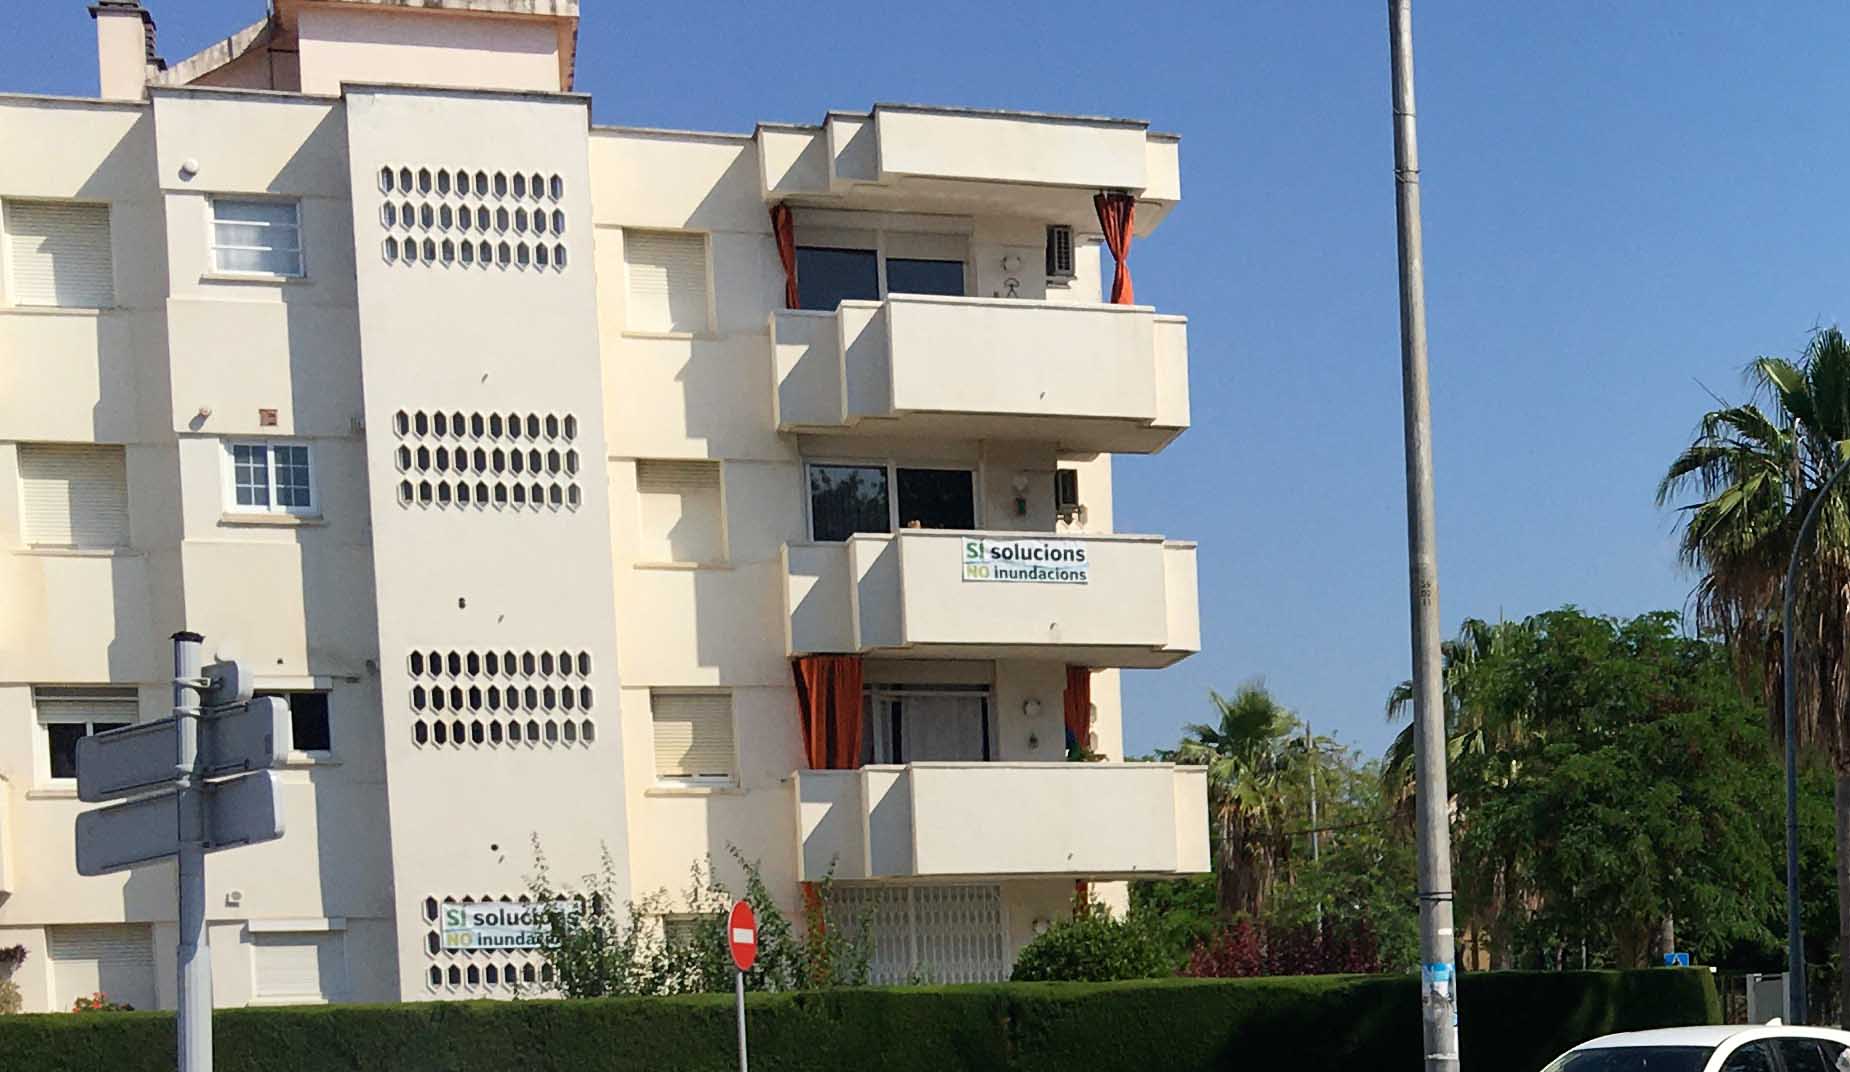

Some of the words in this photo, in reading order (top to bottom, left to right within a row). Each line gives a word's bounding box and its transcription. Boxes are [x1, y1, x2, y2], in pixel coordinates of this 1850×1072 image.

[991, 543, 1086, 562] solucions
[966, 566, 989, 579] NO
[994, 565, 1087, 581] inundacions
[447, 932, 473, 946] NO
